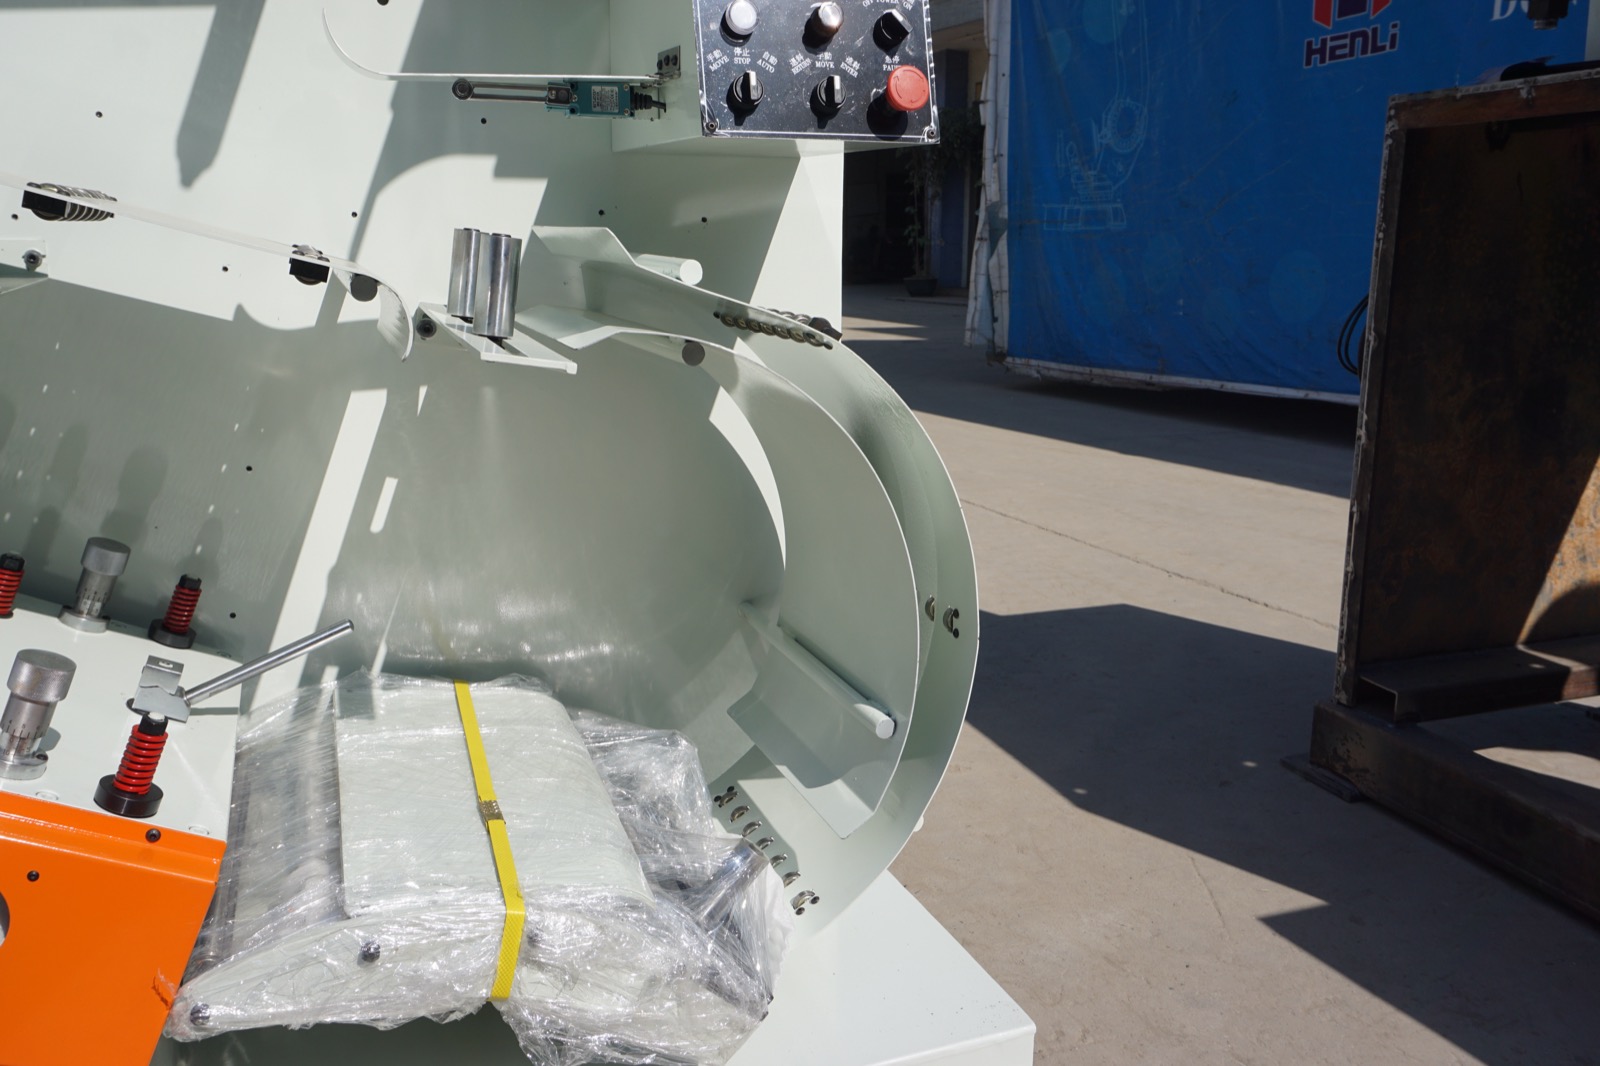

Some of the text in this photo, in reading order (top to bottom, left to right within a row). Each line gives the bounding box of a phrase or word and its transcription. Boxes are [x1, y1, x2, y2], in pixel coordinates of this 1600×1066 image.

[902, 1, 913, 11] ON
[733, 46, 751, 57] 停止
[709, 55, 730, 72] MOVE
[733, 57, 751, 65] STOP
[756, 59, 775, 74] AUTO
[791, 57, 812, 75] RETURN
[815, 61, 835, 69] MOVE
[840, 61, 859, 78] ENTER
